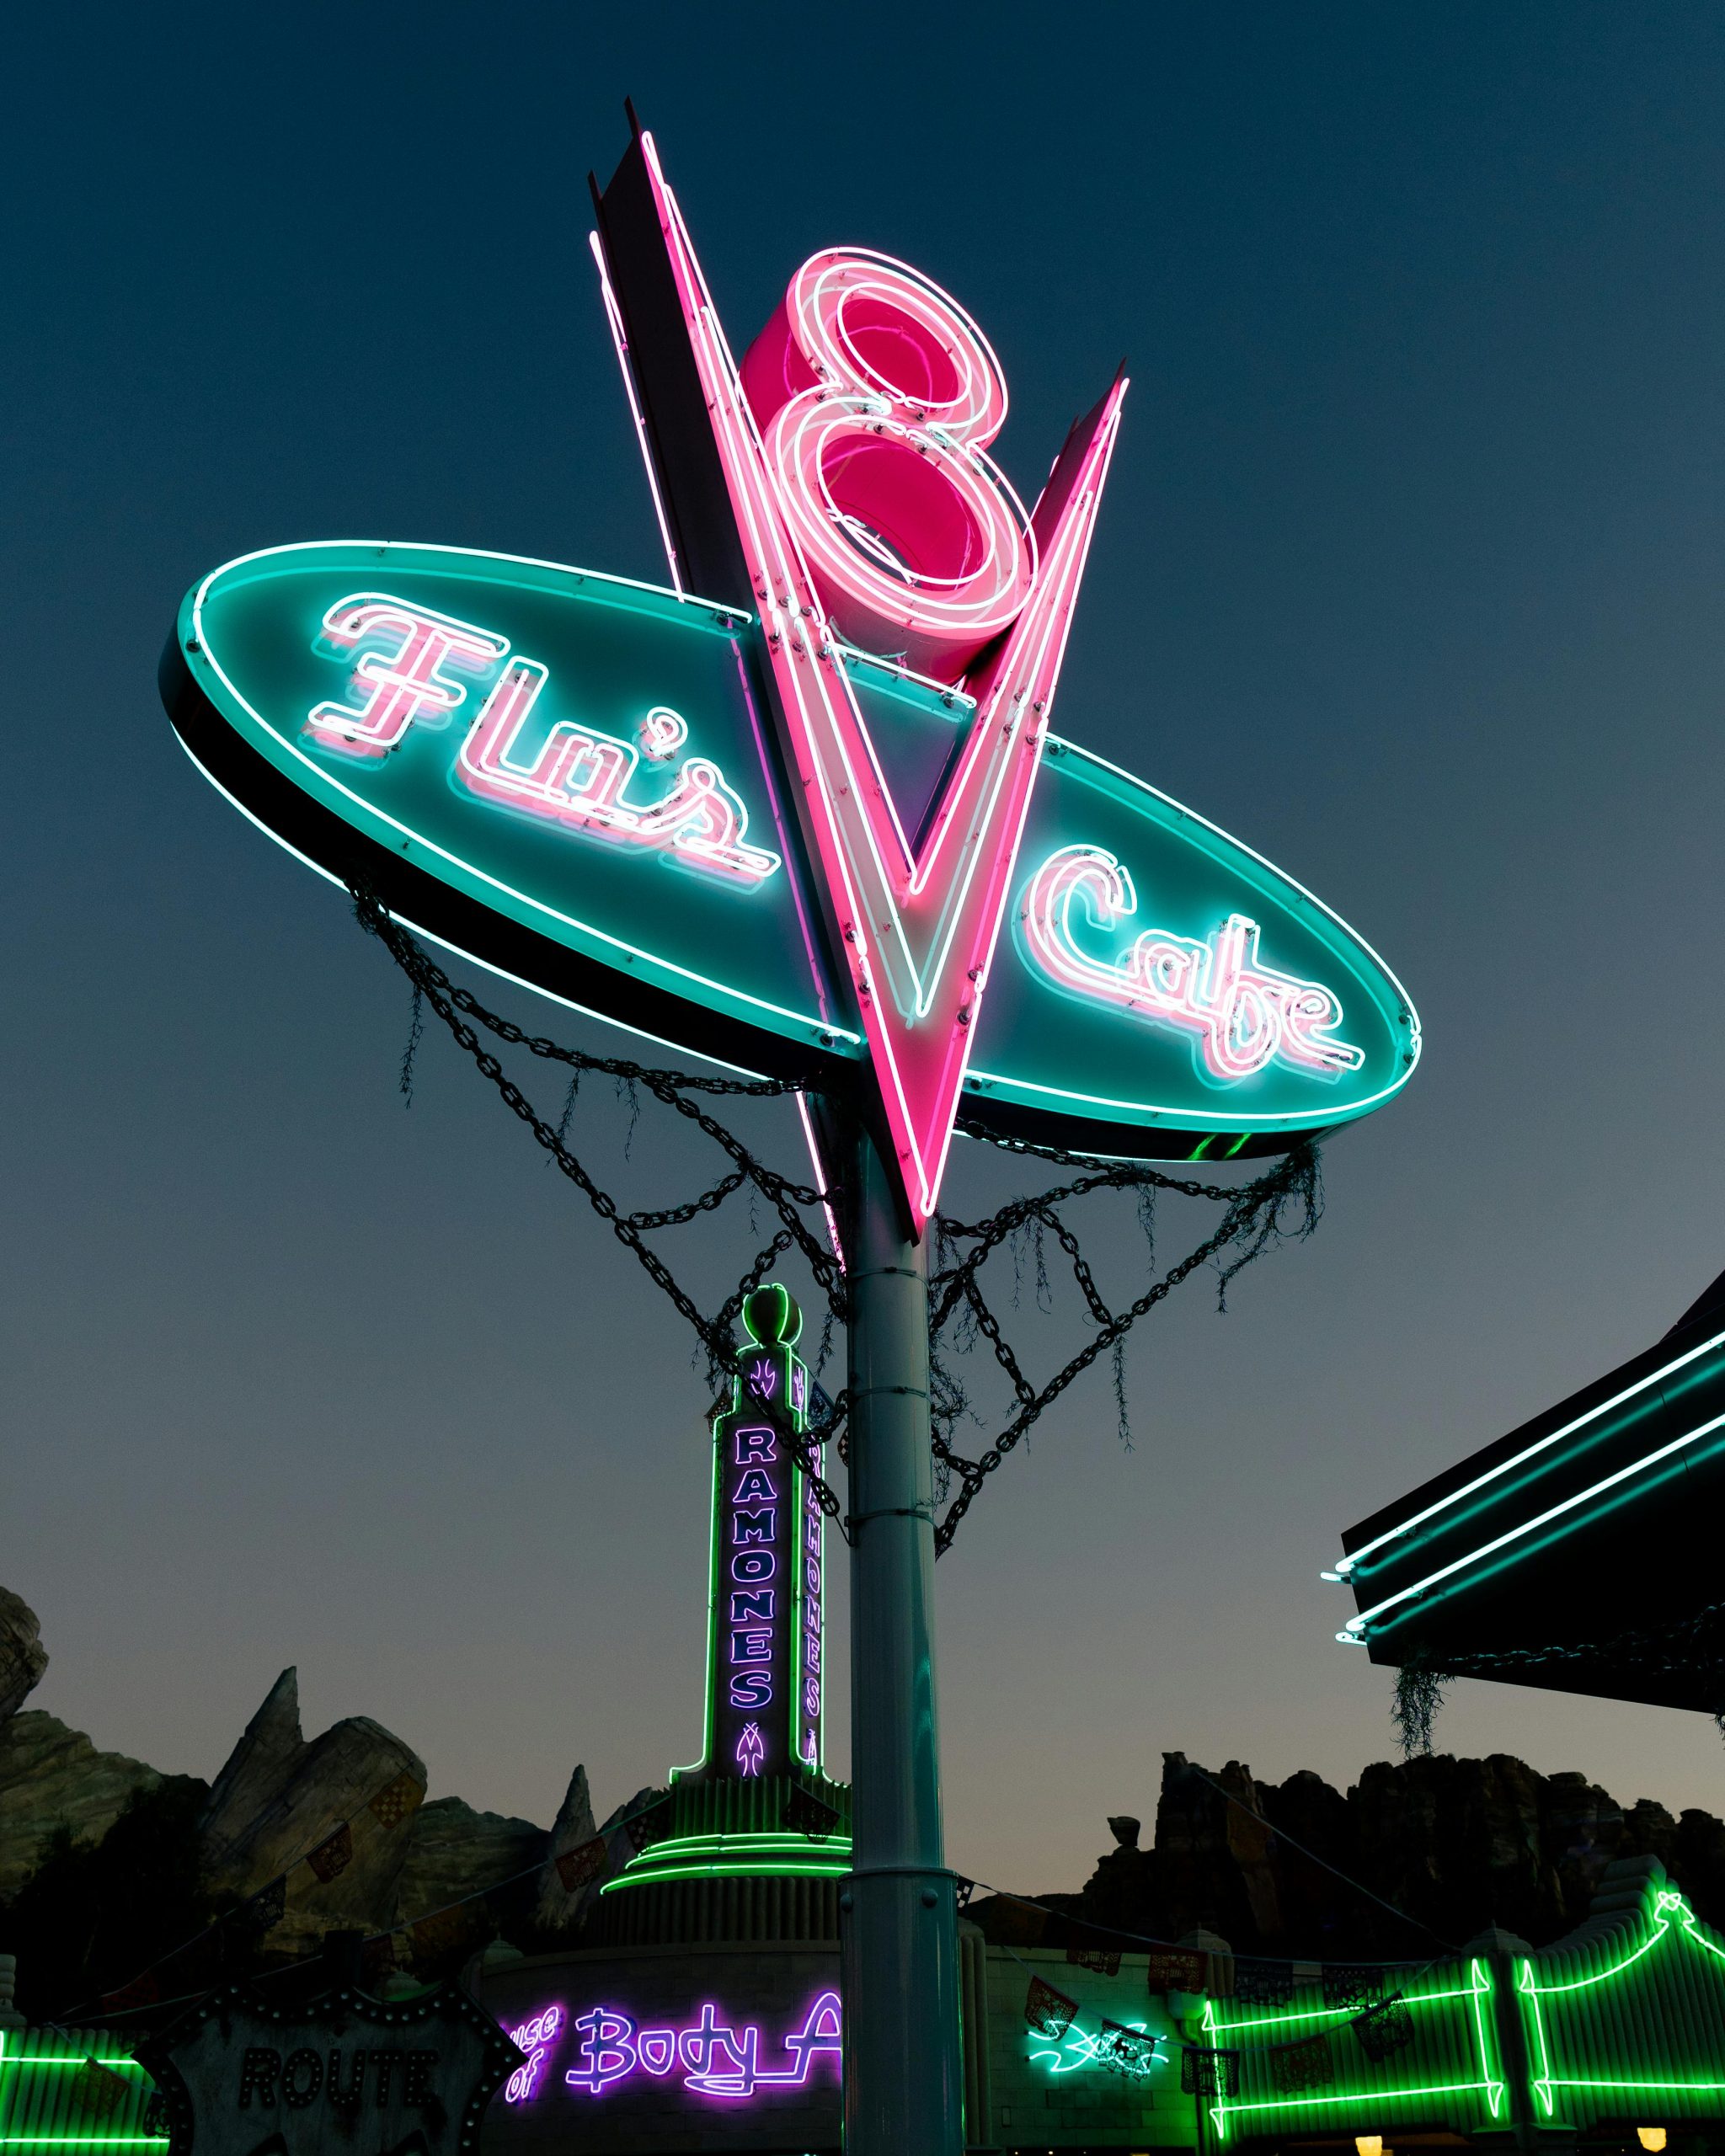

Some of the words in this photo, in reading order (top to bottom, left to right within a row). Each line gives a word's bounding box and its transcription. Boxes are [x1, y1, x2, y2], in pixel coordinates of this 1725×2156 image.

[308, 592, 782, 878] Flo's
[730, 1427, 777, 1710] RAMONES
[240, 2048, 439, 2107] ROUTE
[505, 2047, 544, 2103] of
[565, 2004, 757, 2097] Body
